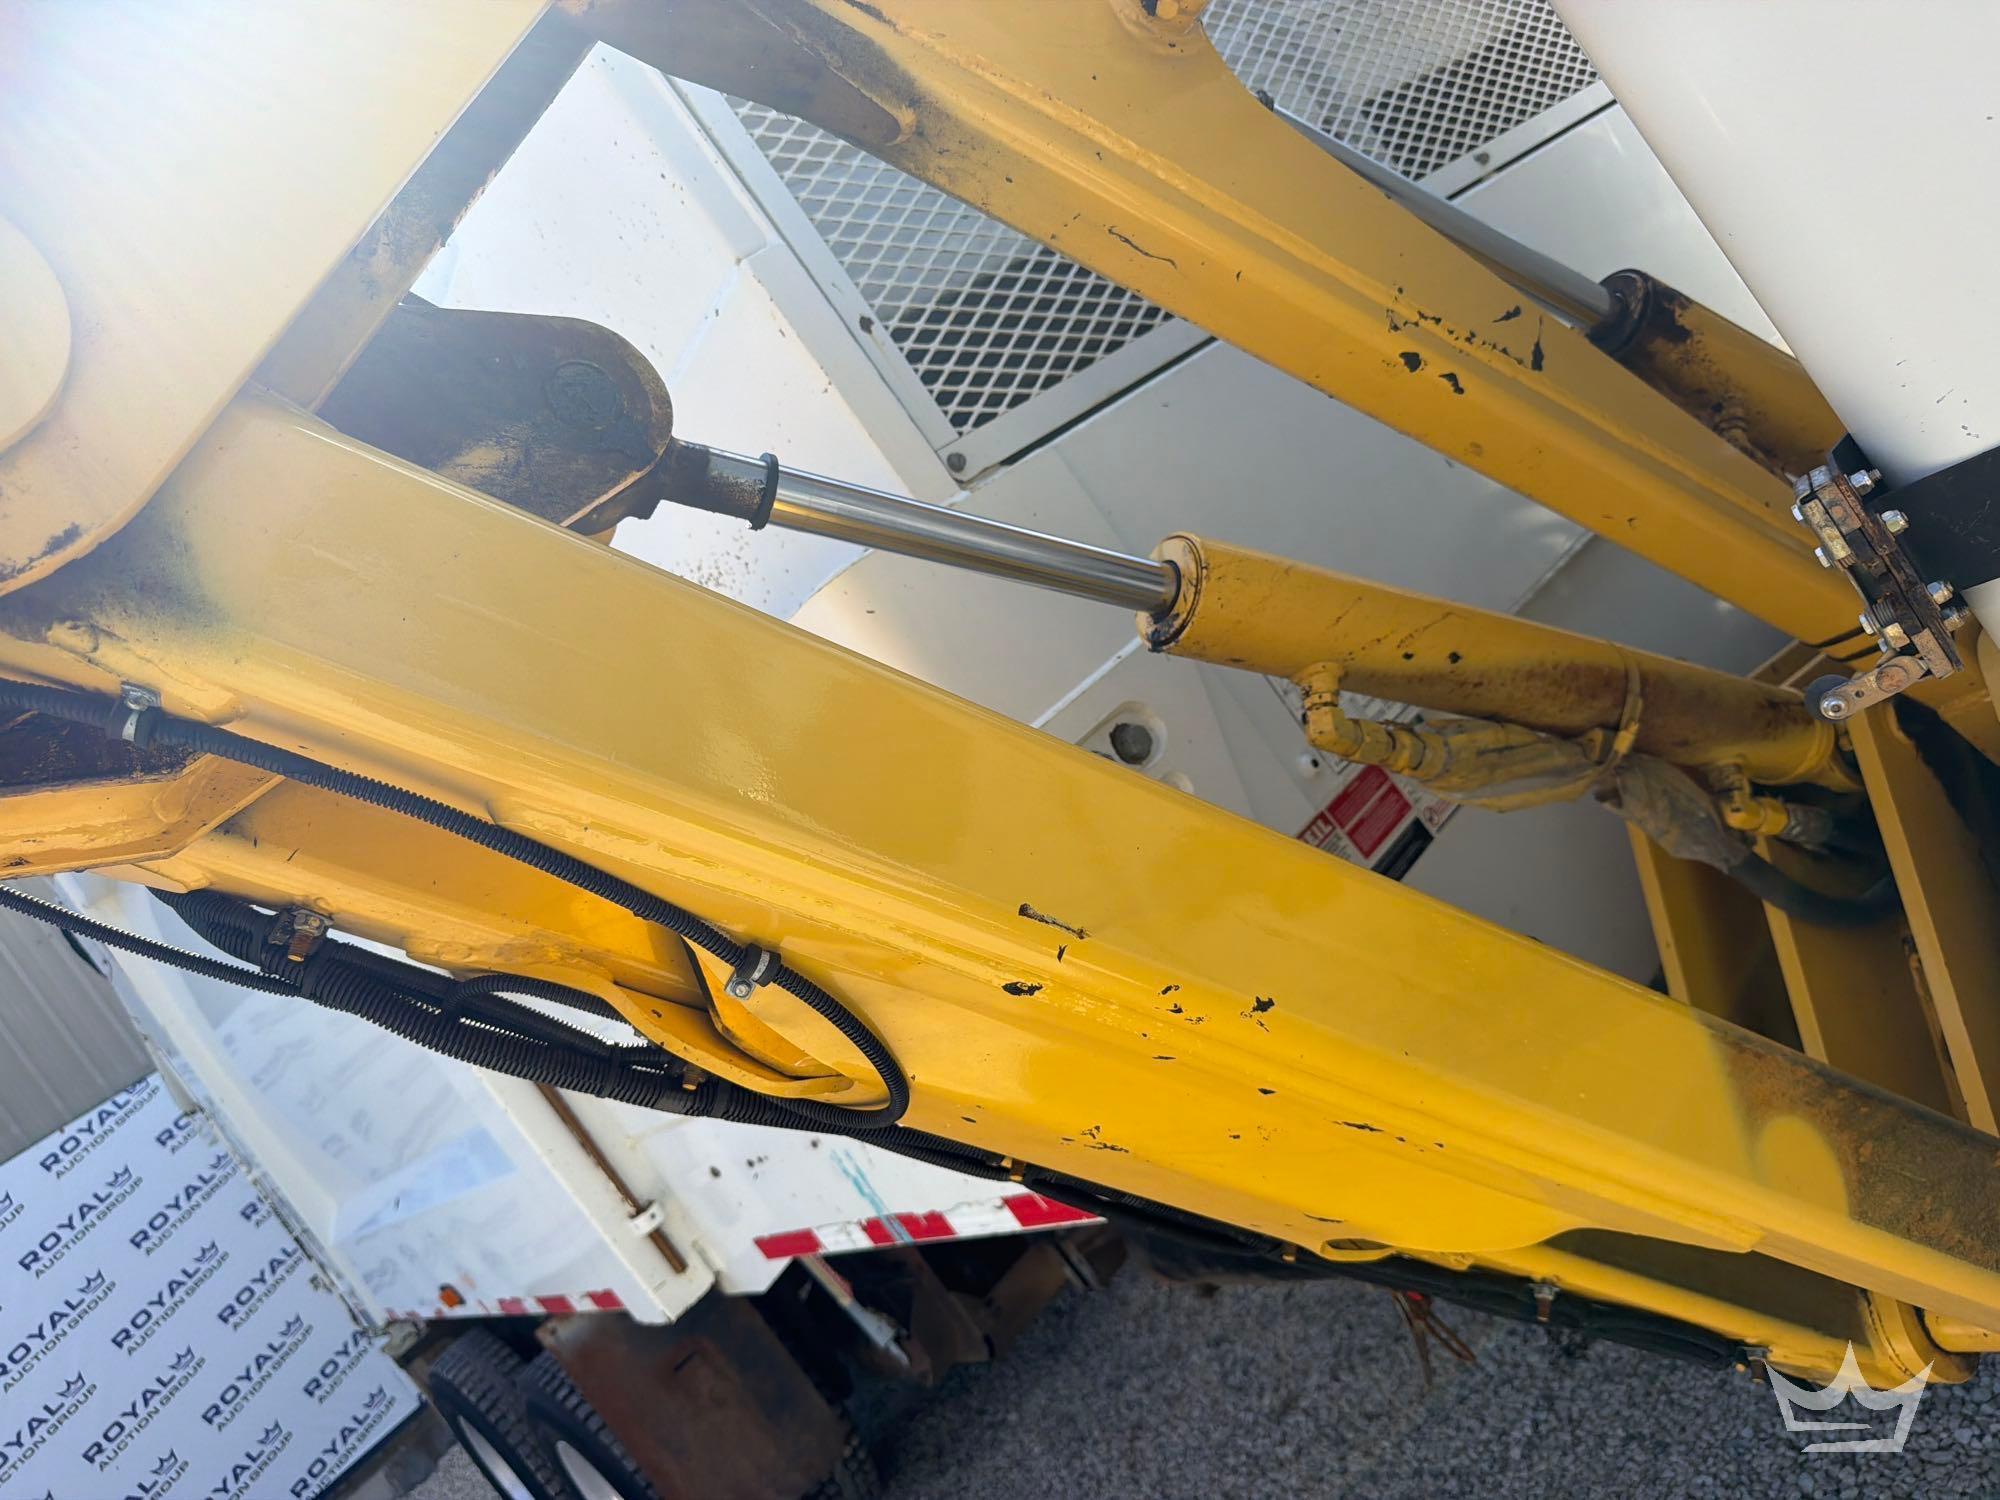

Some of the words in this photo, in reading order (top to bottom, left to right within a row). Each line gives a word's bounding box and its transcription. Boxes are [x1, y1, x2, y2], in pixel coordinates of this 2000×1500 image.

[39, 1099, 132, 1173] ROYAL
[55, 1126, 115, 1180] AUCTION
[115, 1085, 160, 1127] GROUP
[18, 1191, 113, 1271] ROYAL
[34, 1219, 97, 1280] AUCTION
[96, 1176, 143, 1221] GROUP
[129, 1173, 216, 1250] ROYAL
[145, 1200, 201, 1256] AUCTION
[201, 1163, 238, 1202] GROU
[111, 1267, 201, 1350] ROYAL
[127, 1296, 185, 1356] AUCTION
[184, 1251, 229, 1297] GROUP
[217, 1247, 299, 1325] ROYAL
[232, 1274, 286, 1332] AUCTION
[3, 1329, 67, 1394] AUCTION
[67, 1280, 117, 1330] GROUP
[217, 1370, 273, 1432] AUCTION
[271, 1324, 314, 1372] GROUP
[303, 1329, 368, 1398] ROYA
[318, 1345, 368, 1406] AUCTION
[82, 1374, 177, 1464] ROYAL
[99, 1406, 160, 1472] AUCTION
[159, 1356, 206, 1407] GROUP
[201, 1341, 287, 1425] ROYAL
[355, 1396, 397, 1445] GROUP
[0, 1435, 47, 1484] CTION
[46, 1383, 97, 1436] GROUP
[205, 1450, 265, 1500] YAL
[249, 1431, 293, 1482] GROUP
[289, 1412, 371, 1498] ROYAL
